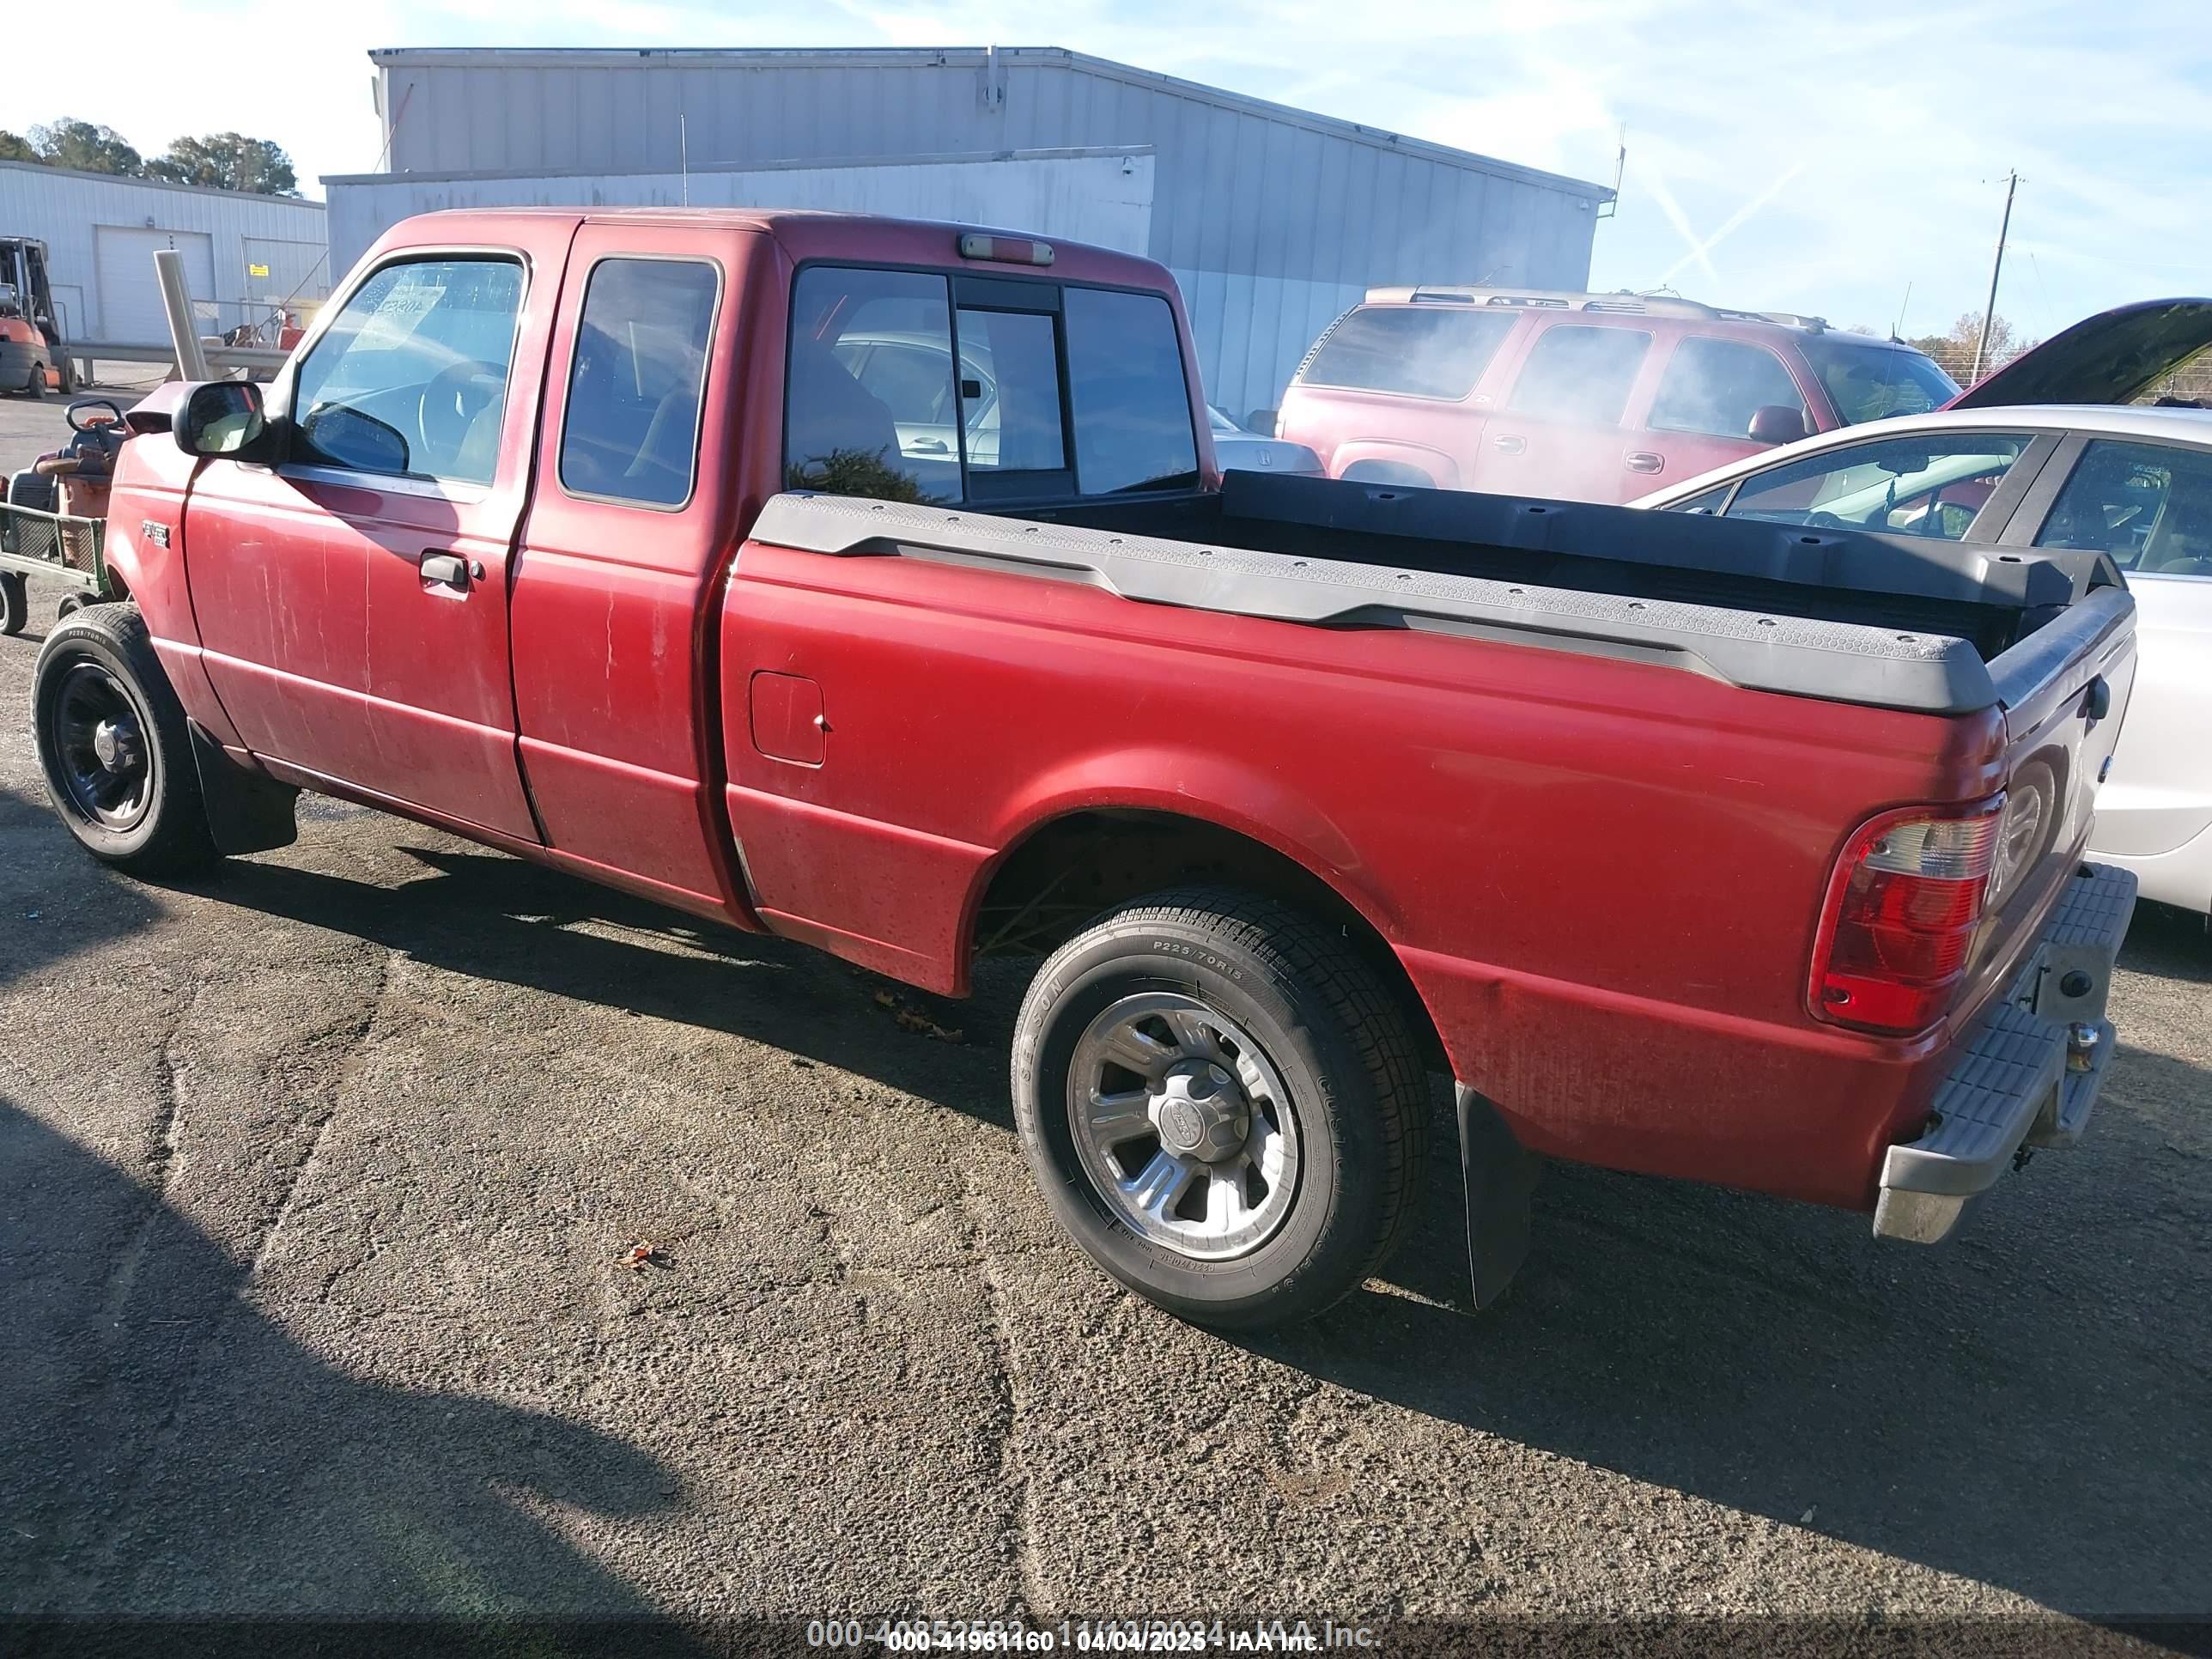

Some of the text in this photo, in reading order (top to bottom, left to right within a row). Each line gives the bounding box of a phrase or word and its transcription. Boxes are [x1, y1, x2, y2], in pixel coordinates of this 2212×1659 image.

[1153, 941, 1243, 980] P225/70R15
[1021, 977, 1066, 1157] ALL SEASON
